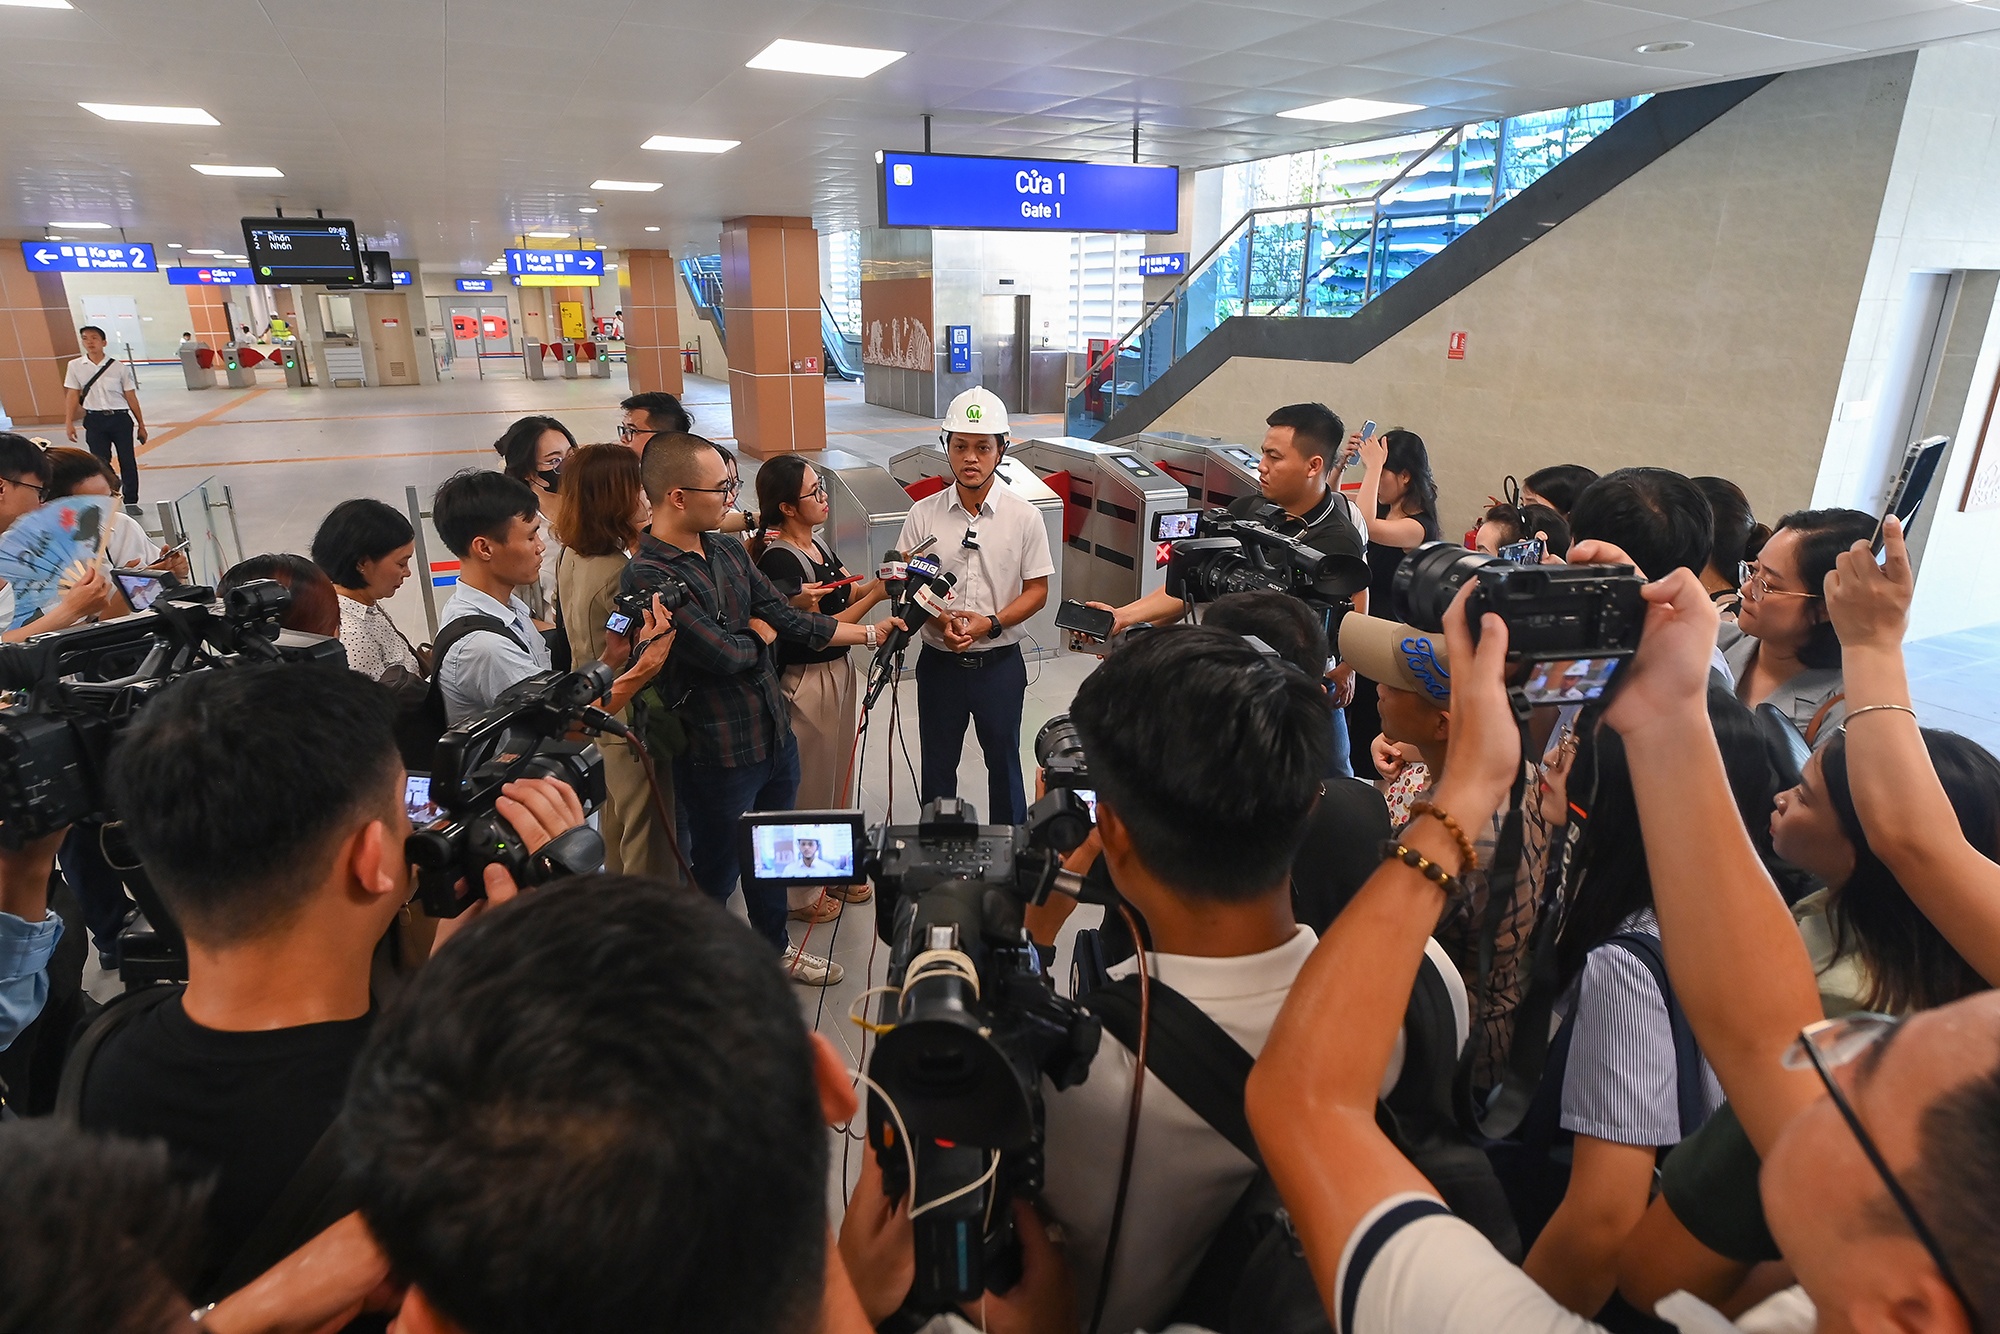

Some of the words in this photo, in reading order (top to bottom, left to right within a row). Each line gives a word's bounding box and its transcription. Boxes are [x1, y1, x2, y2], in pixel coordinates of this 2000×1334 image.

[1015, 169, 1053, 195] Cửa
[1057, 172, 1066, 195] 1
[1021, 201, 1052, 218] Gate
[1054, 202, 1061, 218] 1
[255, 242, 260, 250] 2
[341, 243, 351, 251] 12
[129, 247, 148, 269] 2
[513, 253, 522, 272] 1
[963, 347, 968, 361] 1
[911, 560, 936, 573] VTC
[1401, 637, 1450, 700] Ford
